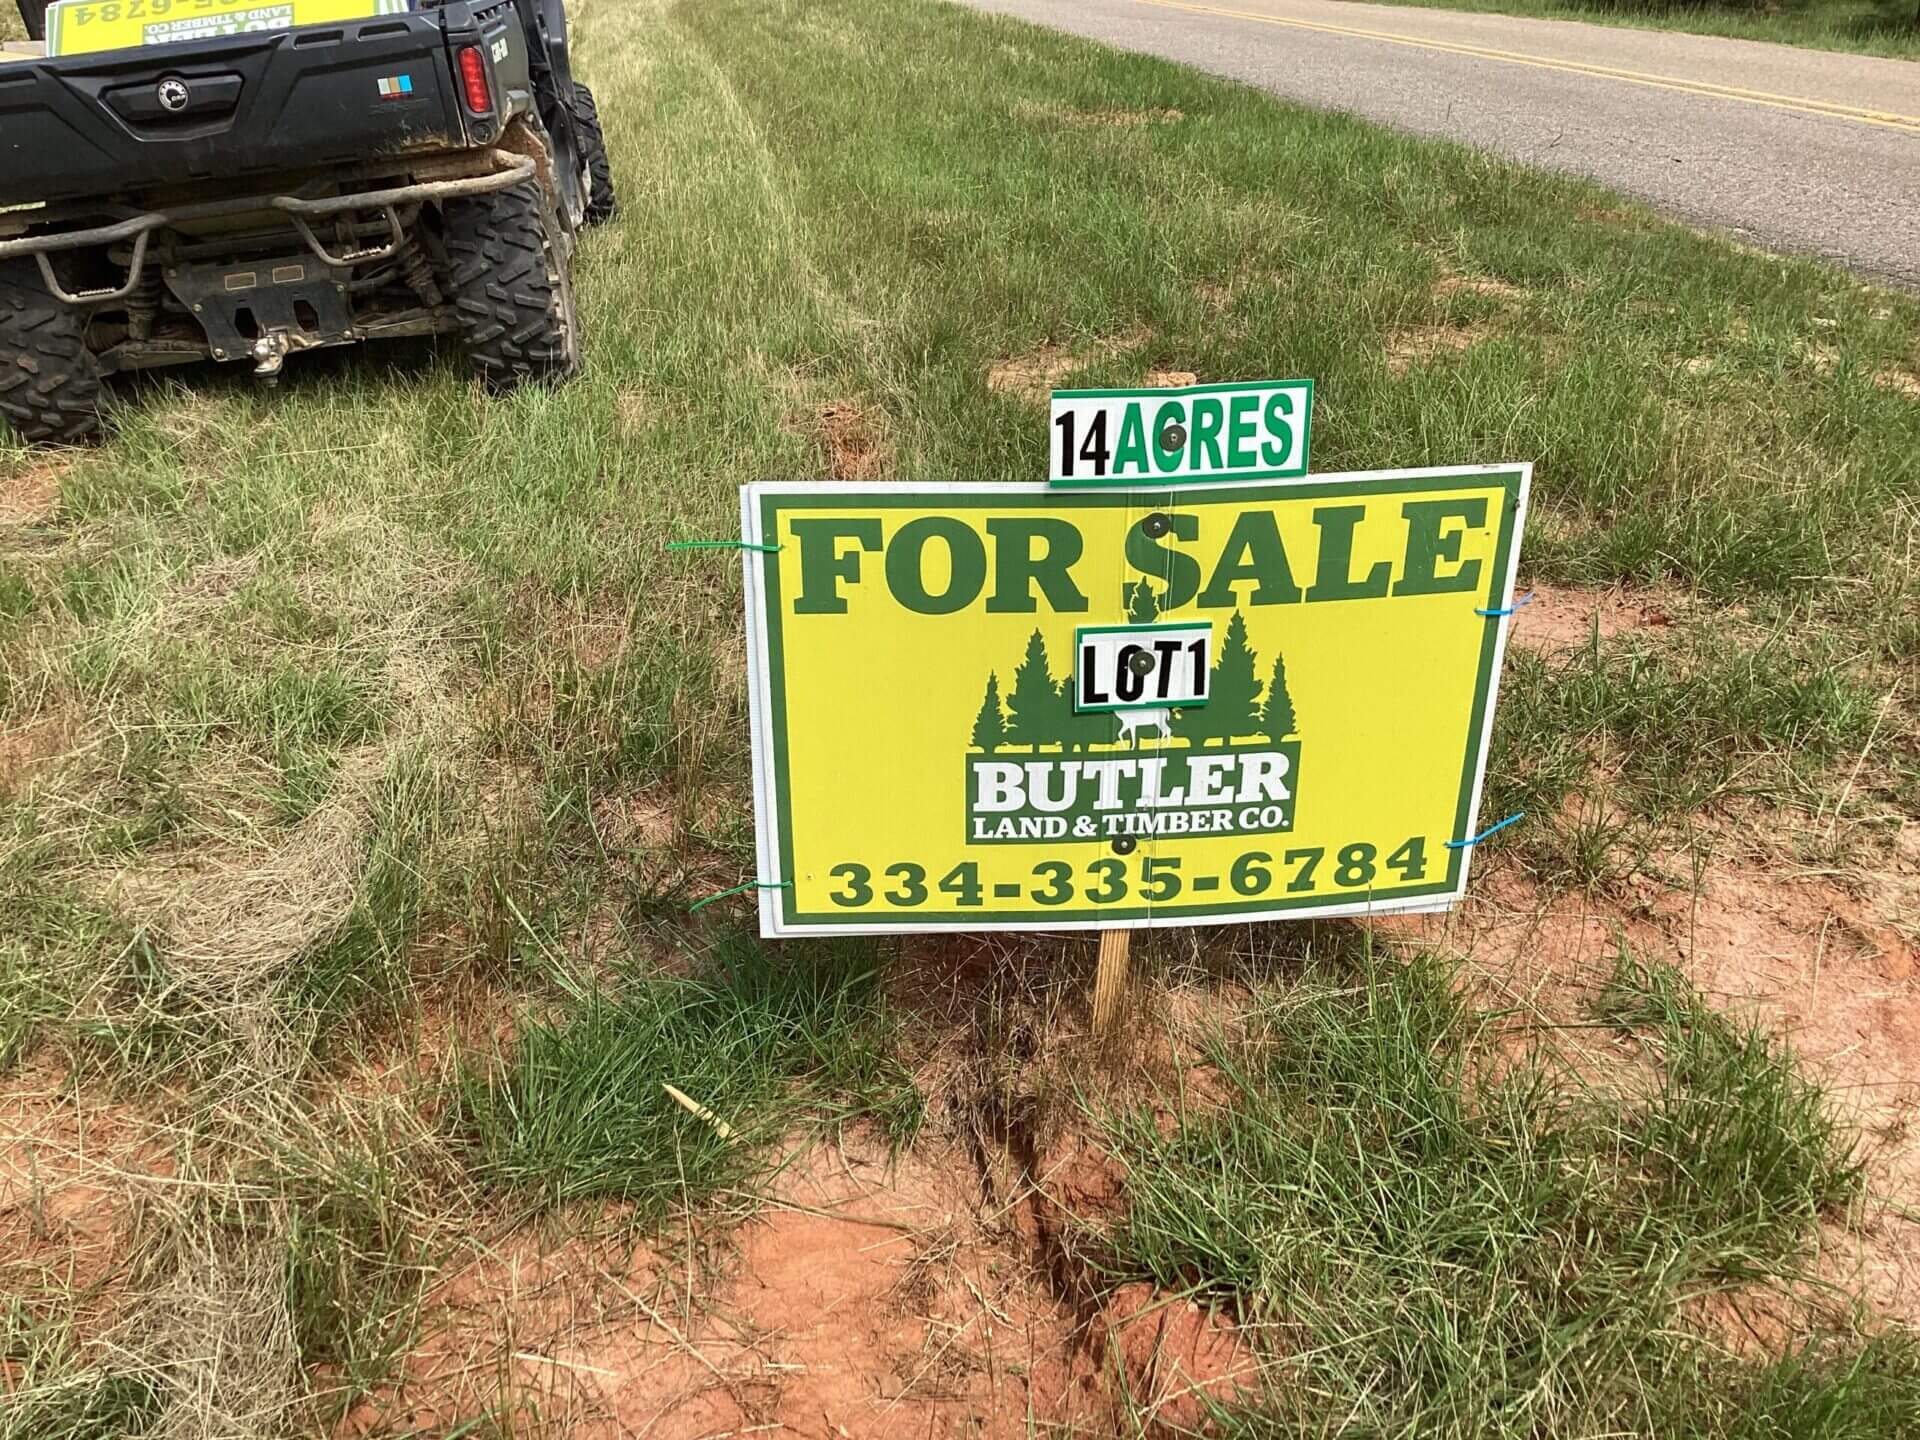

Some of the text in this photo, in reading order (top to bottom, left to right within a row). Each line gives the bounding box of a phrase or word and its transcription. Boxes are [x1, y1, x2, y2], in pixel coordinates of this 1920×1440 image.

[171, 14, 235, 31] TIMBER
[790, 497, 1488, 616] FOR SALE
[972, 751, 1291, 813] BUTLER
[973, 805, 1290, 839] LAND & TIMBER CO.
[829, 836, 1429, 907] 334-335-6784
